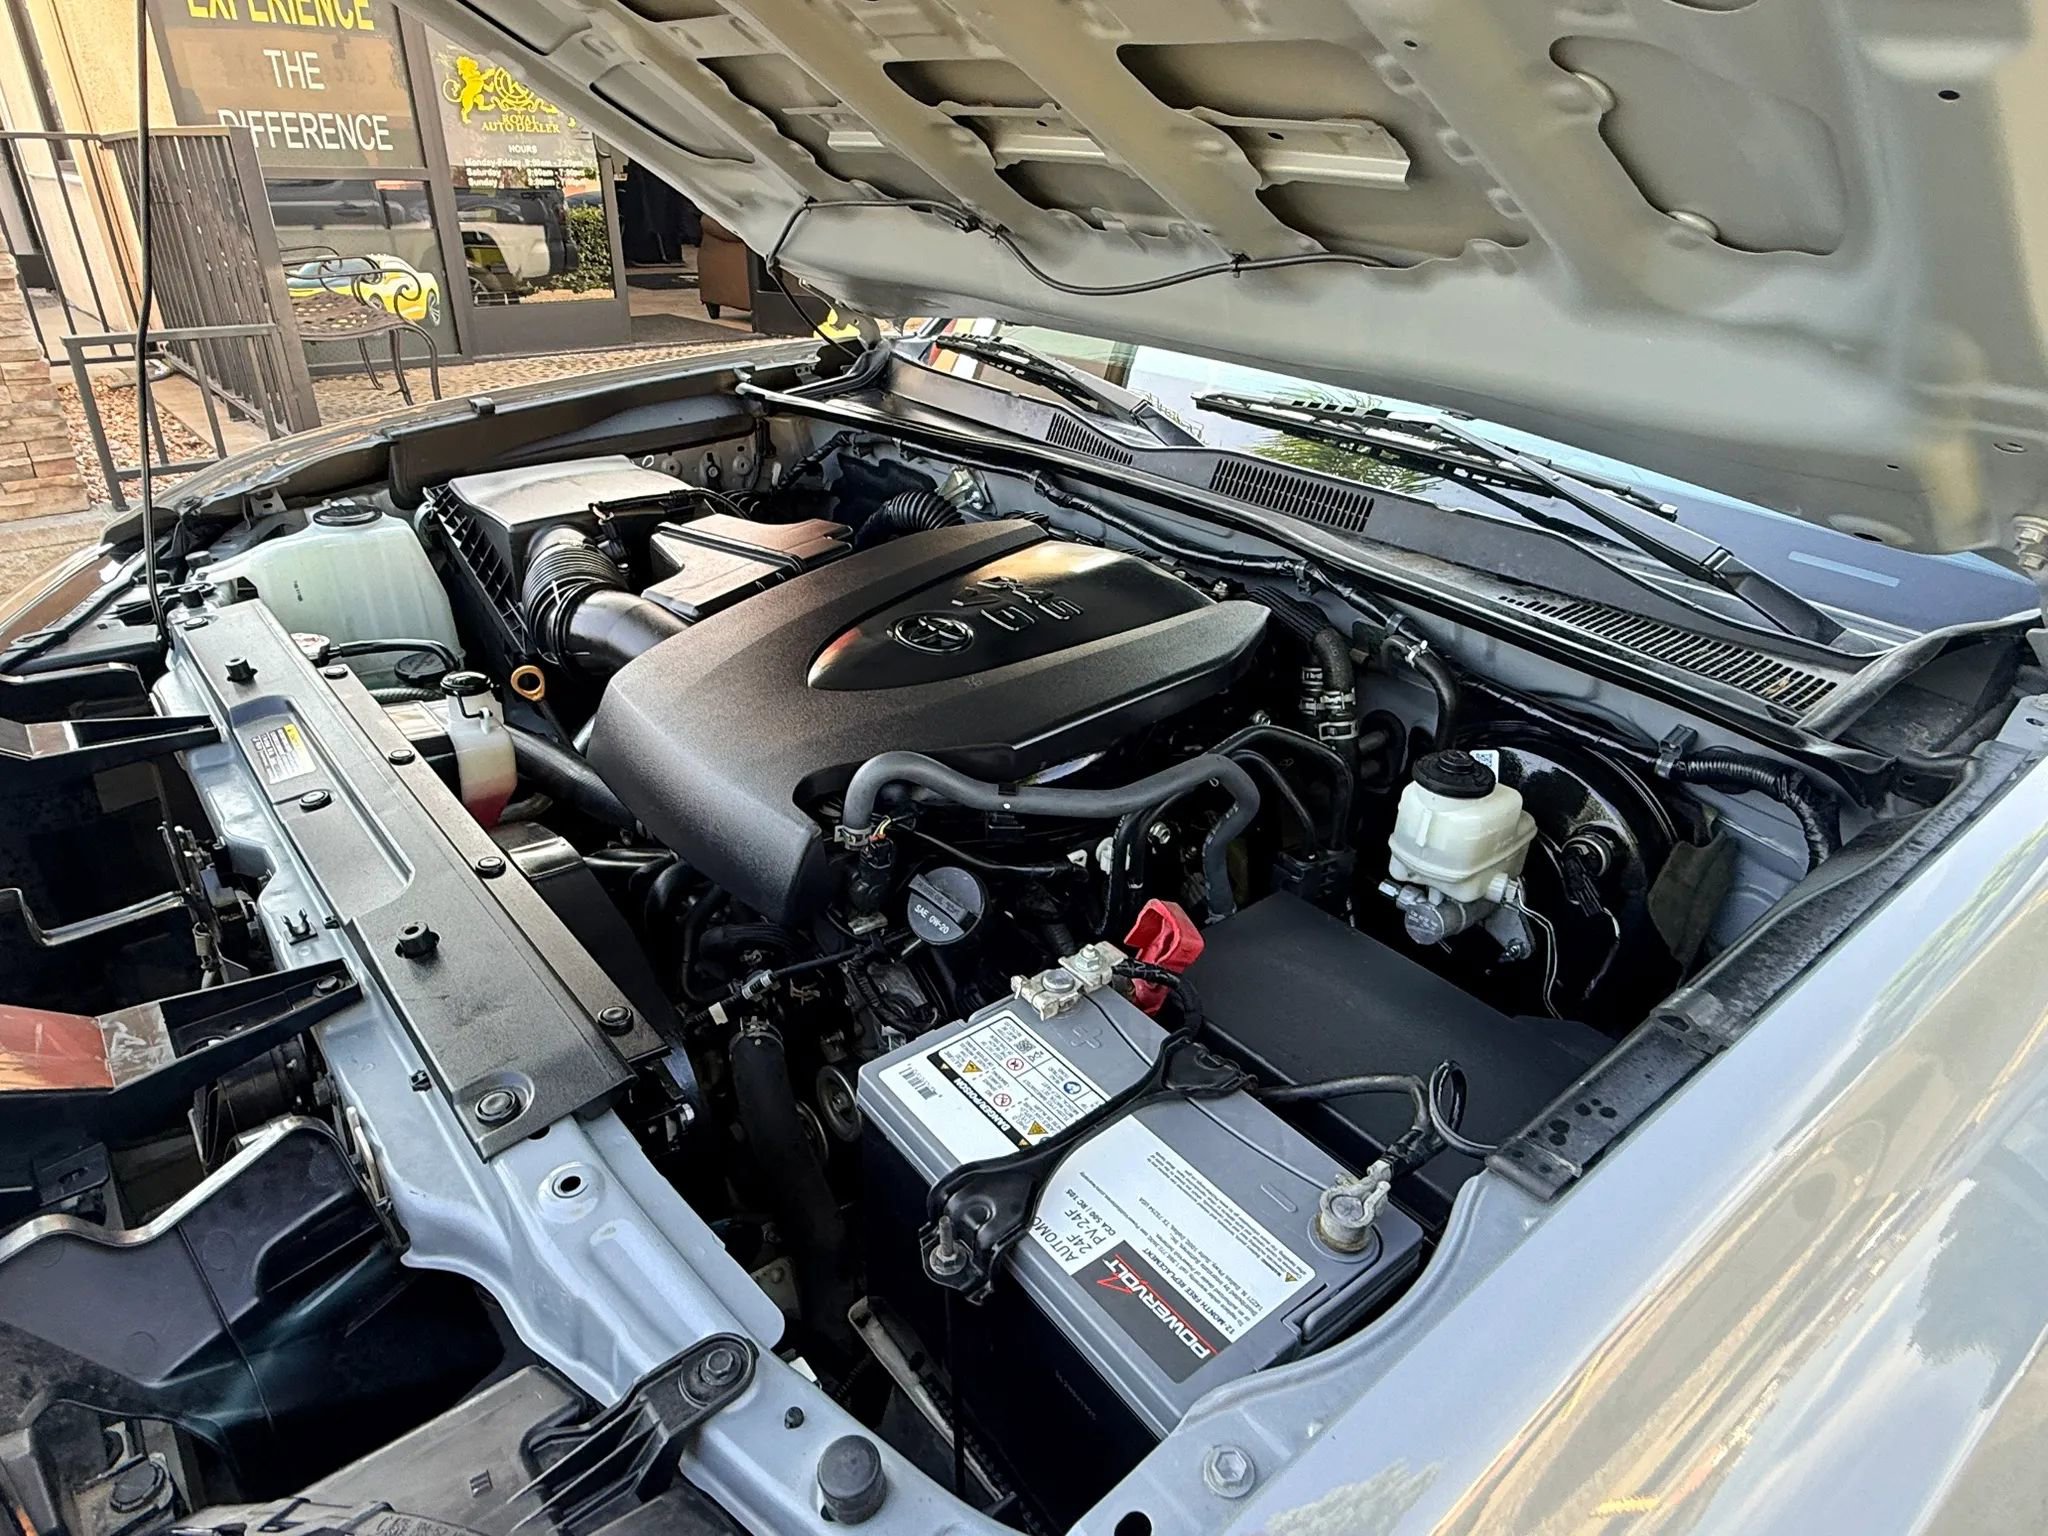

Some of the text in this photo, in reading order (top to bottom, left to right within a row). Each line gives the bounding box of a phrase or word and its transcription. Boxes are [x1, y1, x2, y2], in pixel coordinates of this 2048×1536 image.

[263, 49, 325, 90] THE
[481, 122, 560, 133] AUTO DEALER
[502, 114, 536, 125] ROYAL
[508, 145, 537, 154] HOURS
[914, 904, 950, 934] SAE 0W-20
[950, 1078, 1013, 1130] DANGER/POISON
[1076, 1199, 1088, 1209] RC
[1026, 1214, 1077, 1261] AUTOMO
[1064, 1209, 1106, 1245] PV-24F
[1101, 1221, 1116, 1236] CCA
[1065, 1234, 1092, 1254] 24F
[1142, 1248, 1234, 1334] 12-MONTH FREE REPLACEMENT
[1104, 1259, 1209, 1357] POWERVOLT
